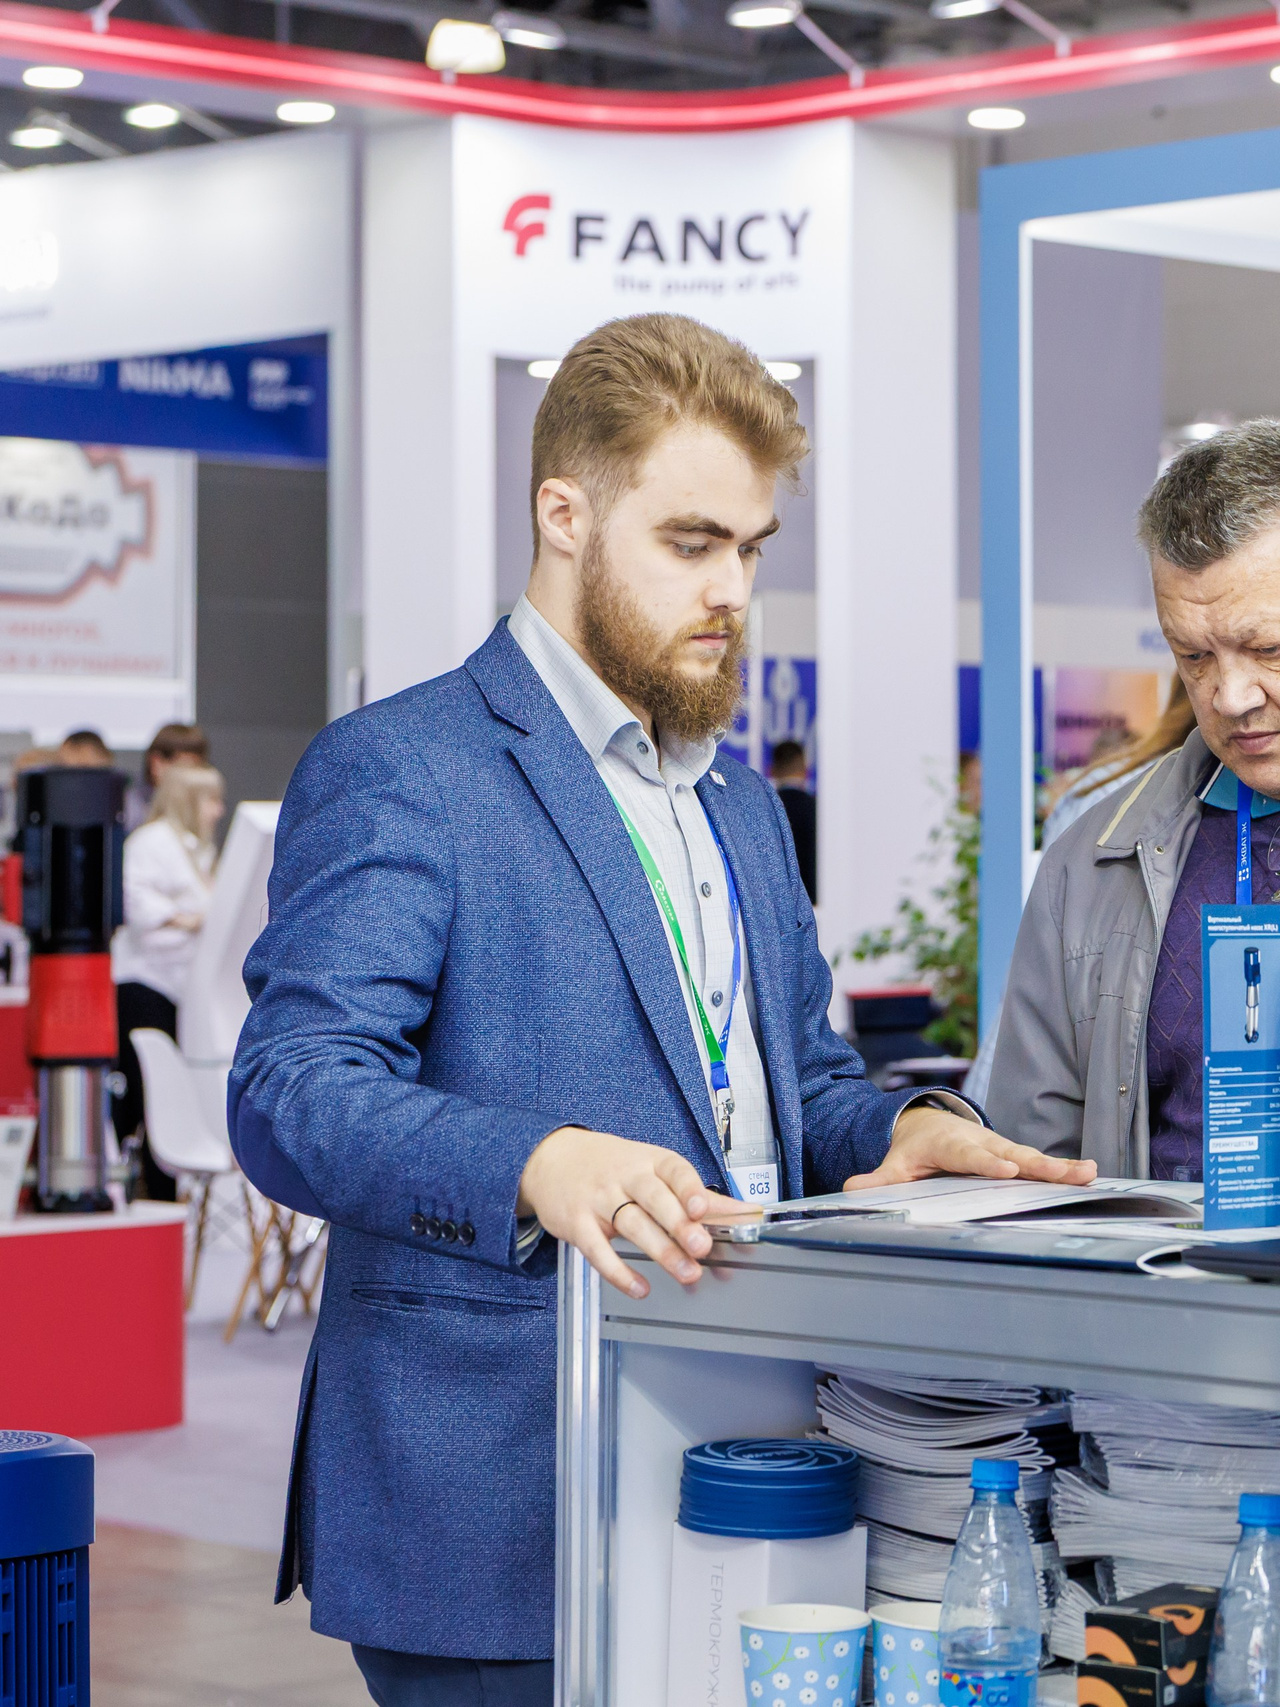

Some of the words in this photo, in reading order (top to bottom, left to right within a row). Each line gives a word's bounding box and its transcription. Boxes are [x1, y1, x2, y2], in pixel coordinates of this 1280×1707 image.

[572, 209, 809, 263] FANCY
[748, 1171, 770, 1180] стенд
[749, 1182, 770, 1195] 8G3
